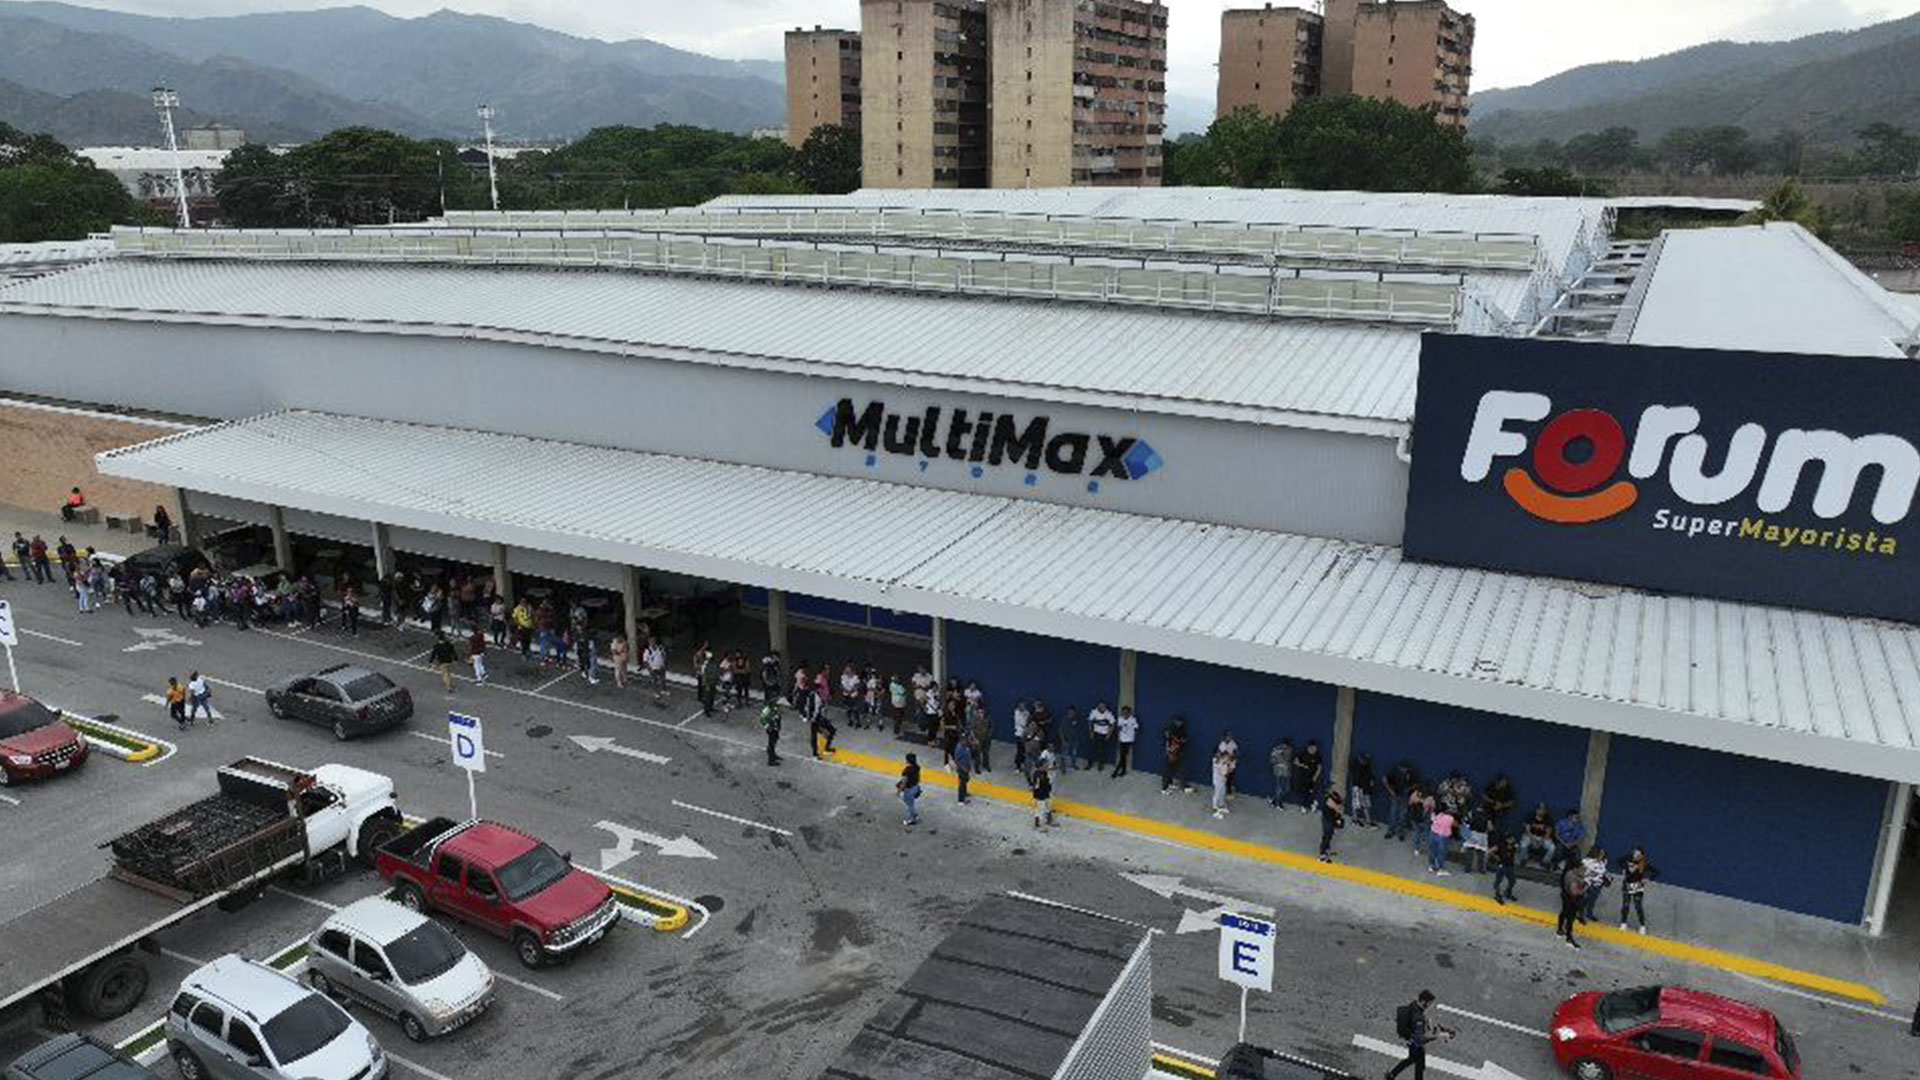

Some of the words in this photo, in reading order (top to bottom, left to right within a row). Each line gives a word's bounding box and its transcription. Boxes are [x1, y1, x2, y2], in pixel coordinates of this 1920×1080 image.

[831, 398, 1137, 480] MultiMax
[1461, 390, 1919, 524] Forum
[1652, 509, 1898, 556] SuperMayorista
[456, 733, 475, 758] D
[1232, 940, 1260, 976] E
